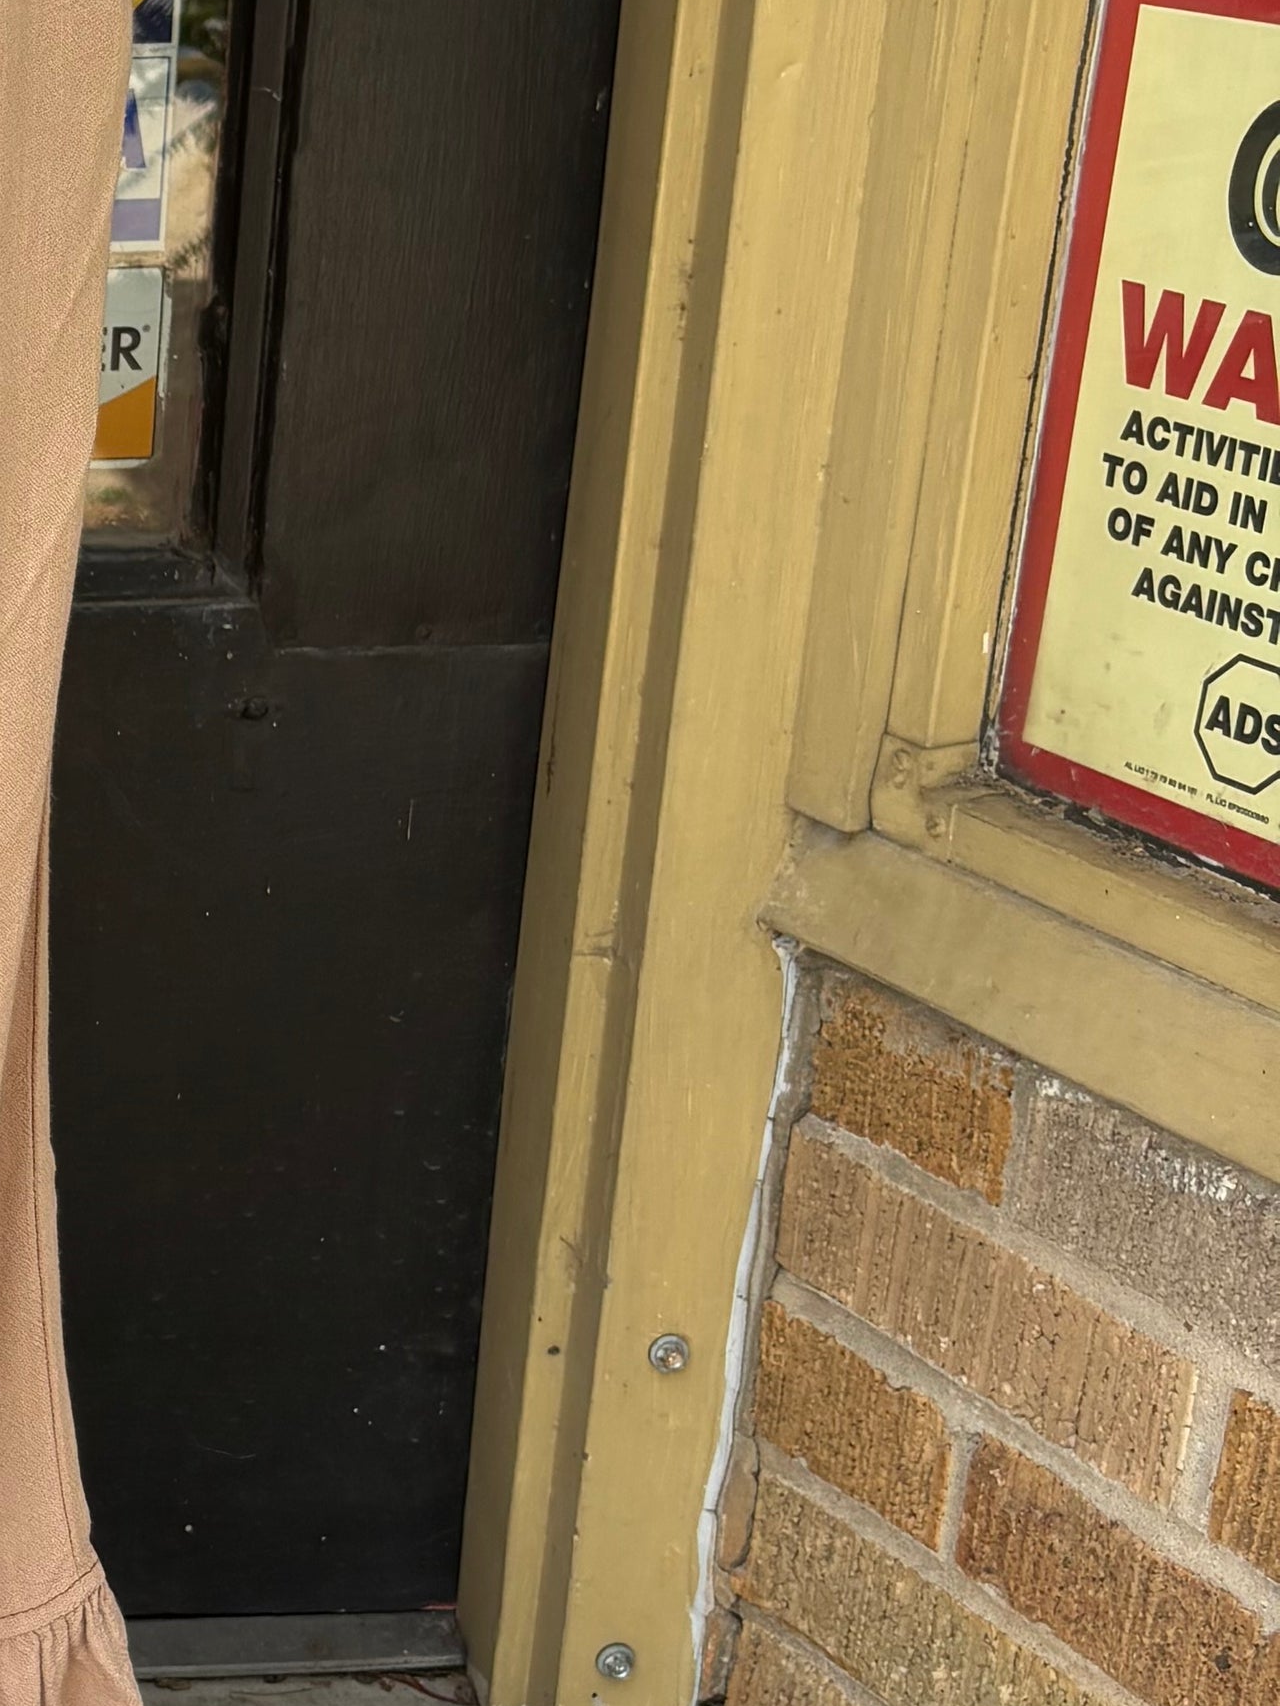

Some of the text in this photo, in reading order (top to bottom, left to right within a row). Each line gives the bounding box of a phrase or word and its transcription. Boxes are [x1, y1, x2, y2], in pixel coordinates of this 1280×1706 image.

[1122, 279, 1280, 426] WA
[1120, 410, 1280, 485] ACTIVITIE
[1103, 452, 1268, 534] TO AID IN
[1107, 507, 1155, 547] OF
[1160, 525, 1238, 574] ANY
[1131, 567, 1280, 645] AGAINST
[1205, 695, 1280, 756] ADS
